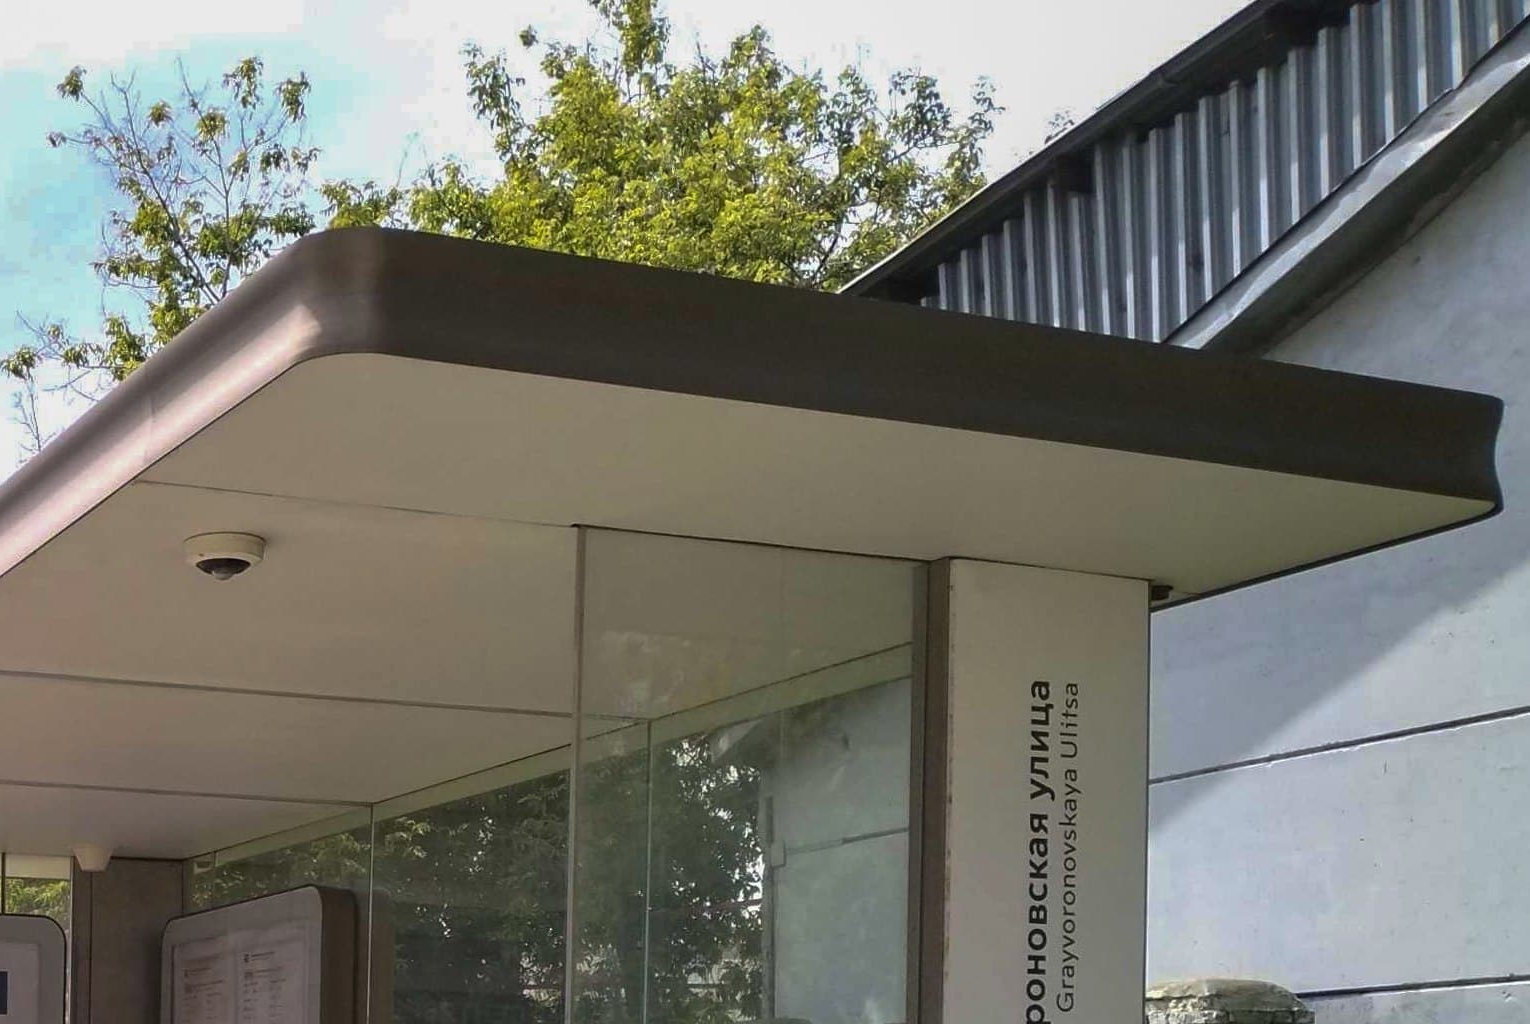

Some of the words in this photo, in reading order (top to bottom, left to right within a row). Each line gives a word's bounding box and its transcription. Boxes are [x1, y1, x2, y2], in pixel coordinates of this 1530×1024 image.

[1029, 680, 1055, 801] улица
[1059, 682, 1079, 759] Ulitsa
[1057, 768, 1081, 1013] Grayvoronovskaya
